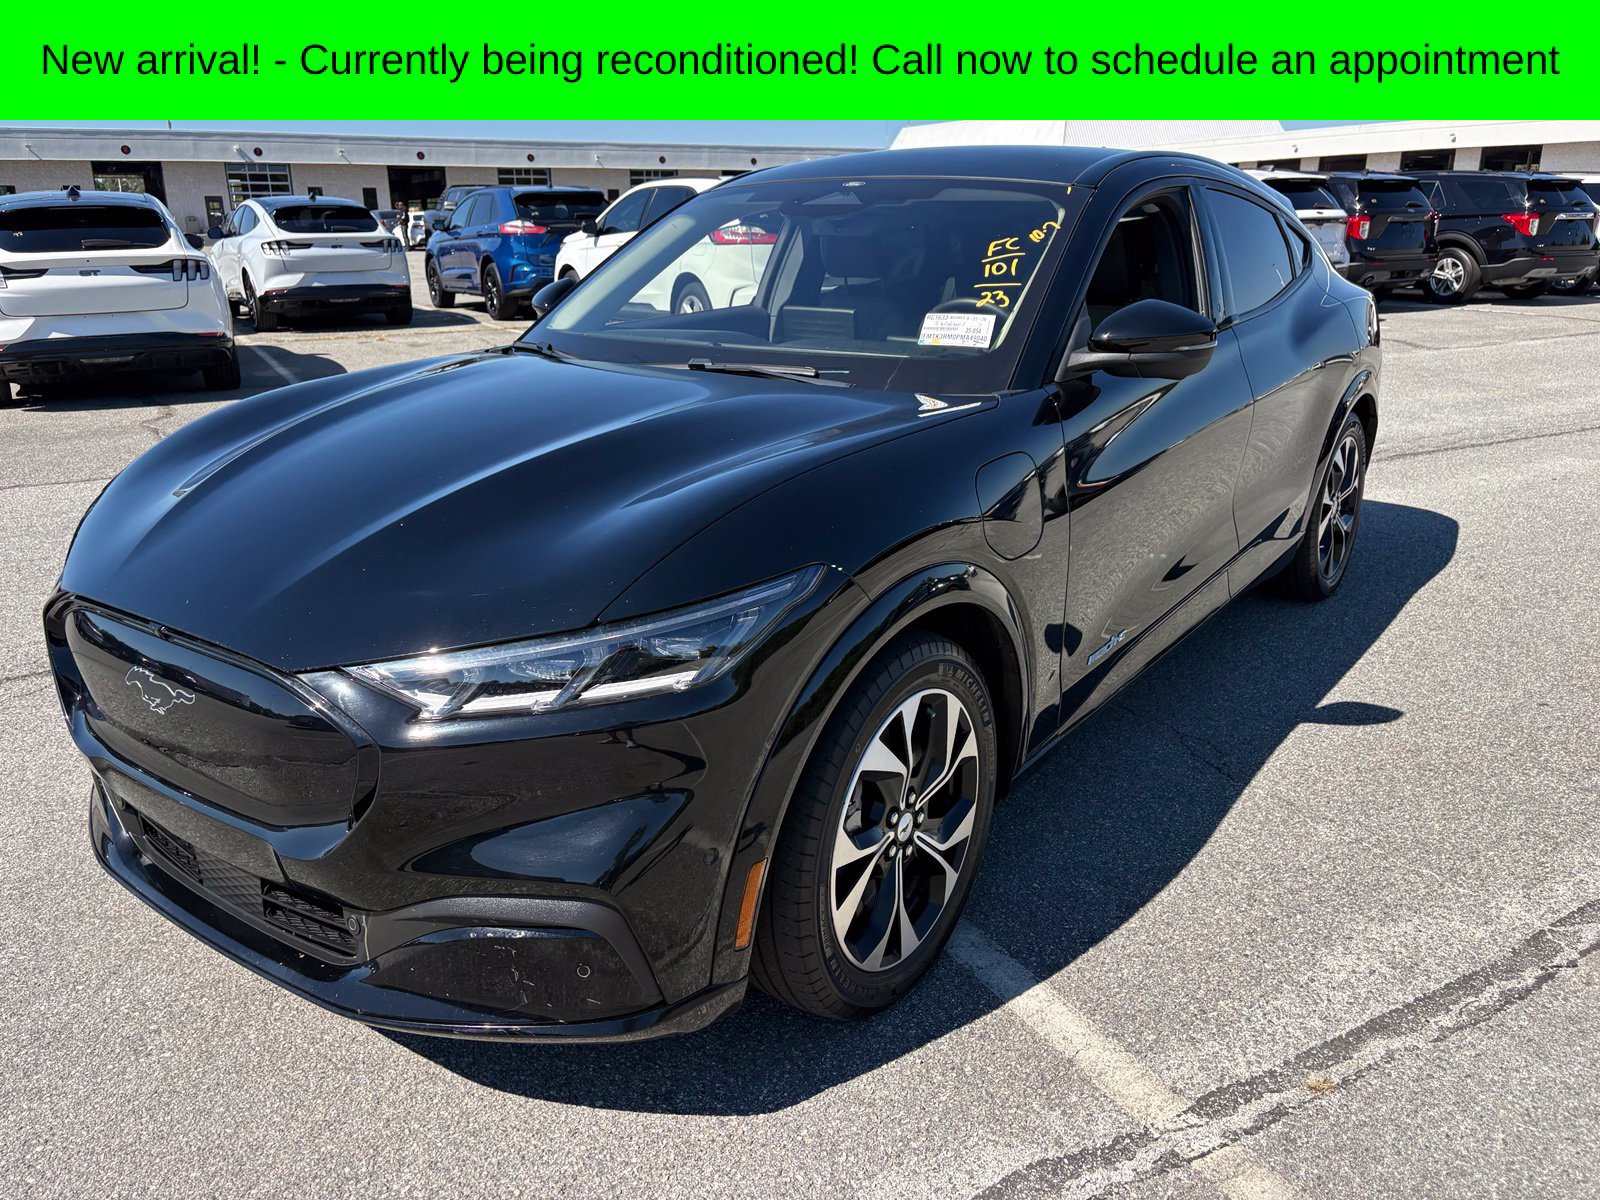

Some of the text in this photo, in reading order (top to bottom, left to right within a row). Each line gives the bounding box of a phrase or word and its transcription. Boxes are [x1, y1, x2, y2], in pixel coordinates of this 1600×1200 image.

[987, 237, 1021, 257] FC
[983, 258, 1019, 278] 101
[975, 290, 1010, 308] 23
[955, 669, 991, 724] MICHELIN
